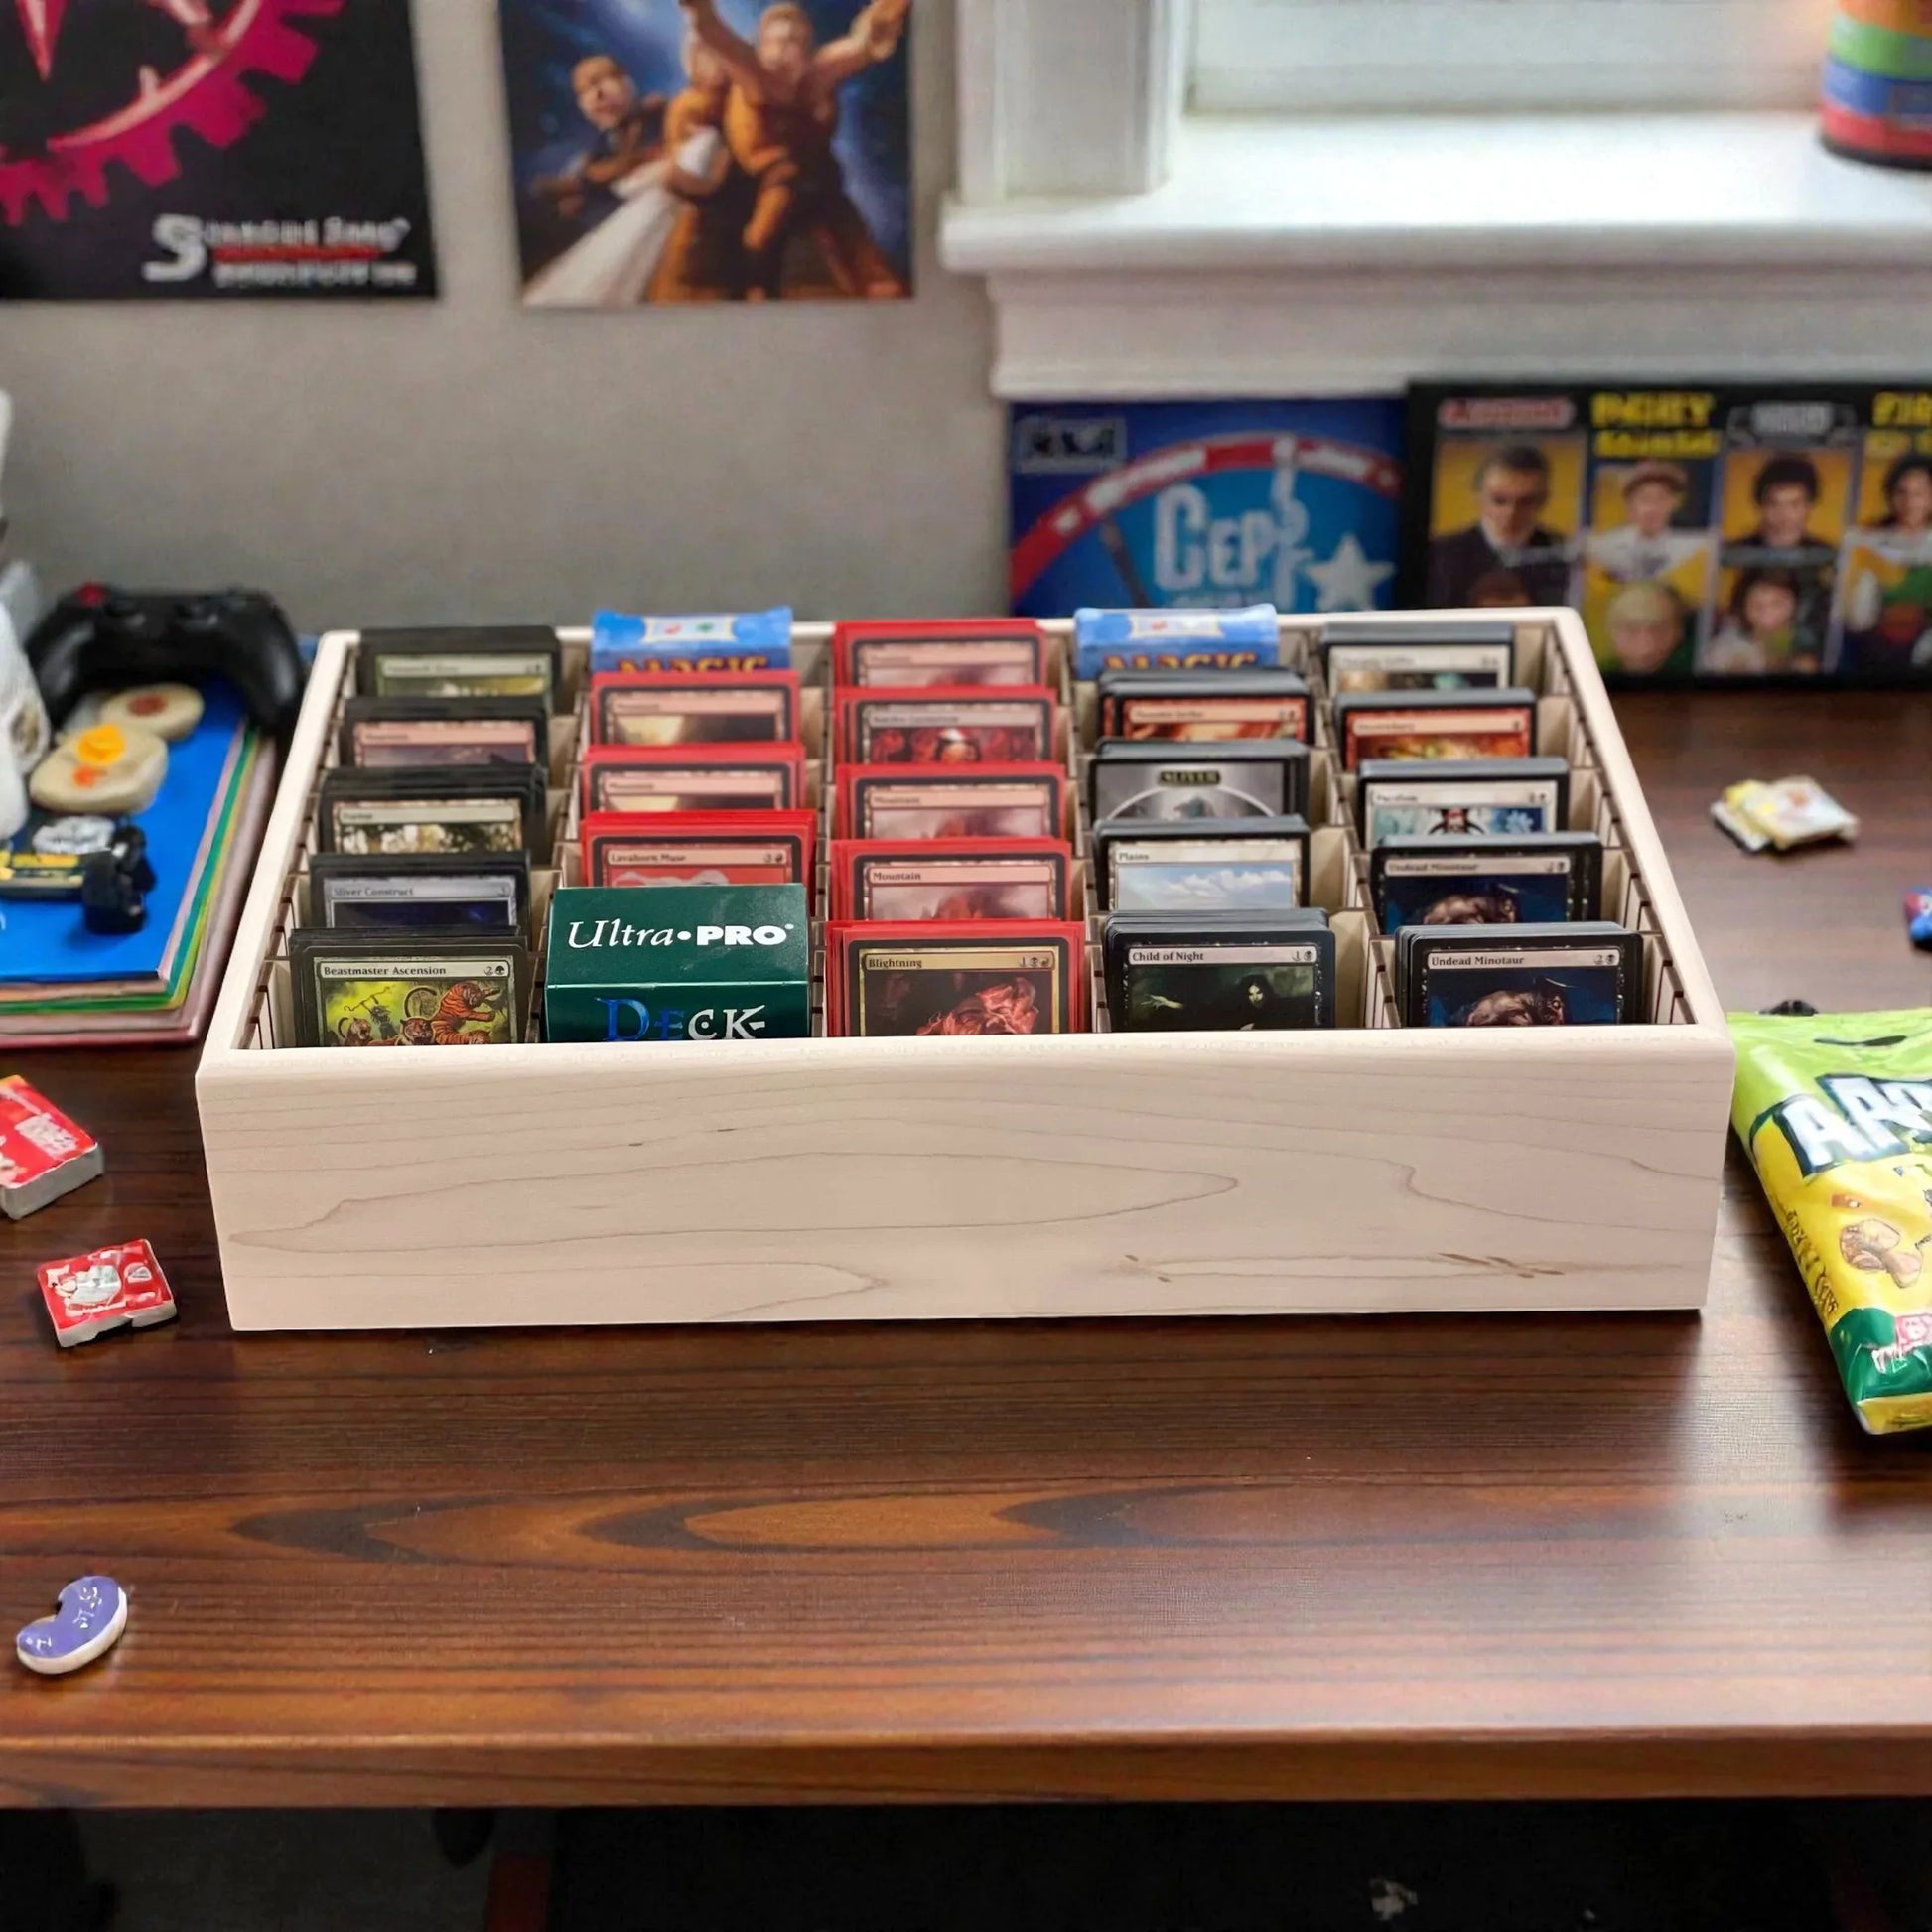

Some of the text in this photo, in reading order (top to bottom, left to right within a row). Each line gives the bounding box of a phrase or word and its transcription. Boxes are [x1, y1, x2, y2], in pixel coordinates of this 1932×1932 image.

[873, 870, 921, 881] Mountain
[696, 924, 787, 946] PRO
[1132, 952, 1160, 962] Child
[1163, 951, 1174, 961] of
[1175, 951, 1204, 963] Night
[1432, 956, 1472, 966] Undead
[1474, 956, 1525, 966] Minotaur
[868, 957, 922, 969] Blightning
[324, 966, 390, 976] Beastmaster
[392, 966, 447, 976] Ascension
